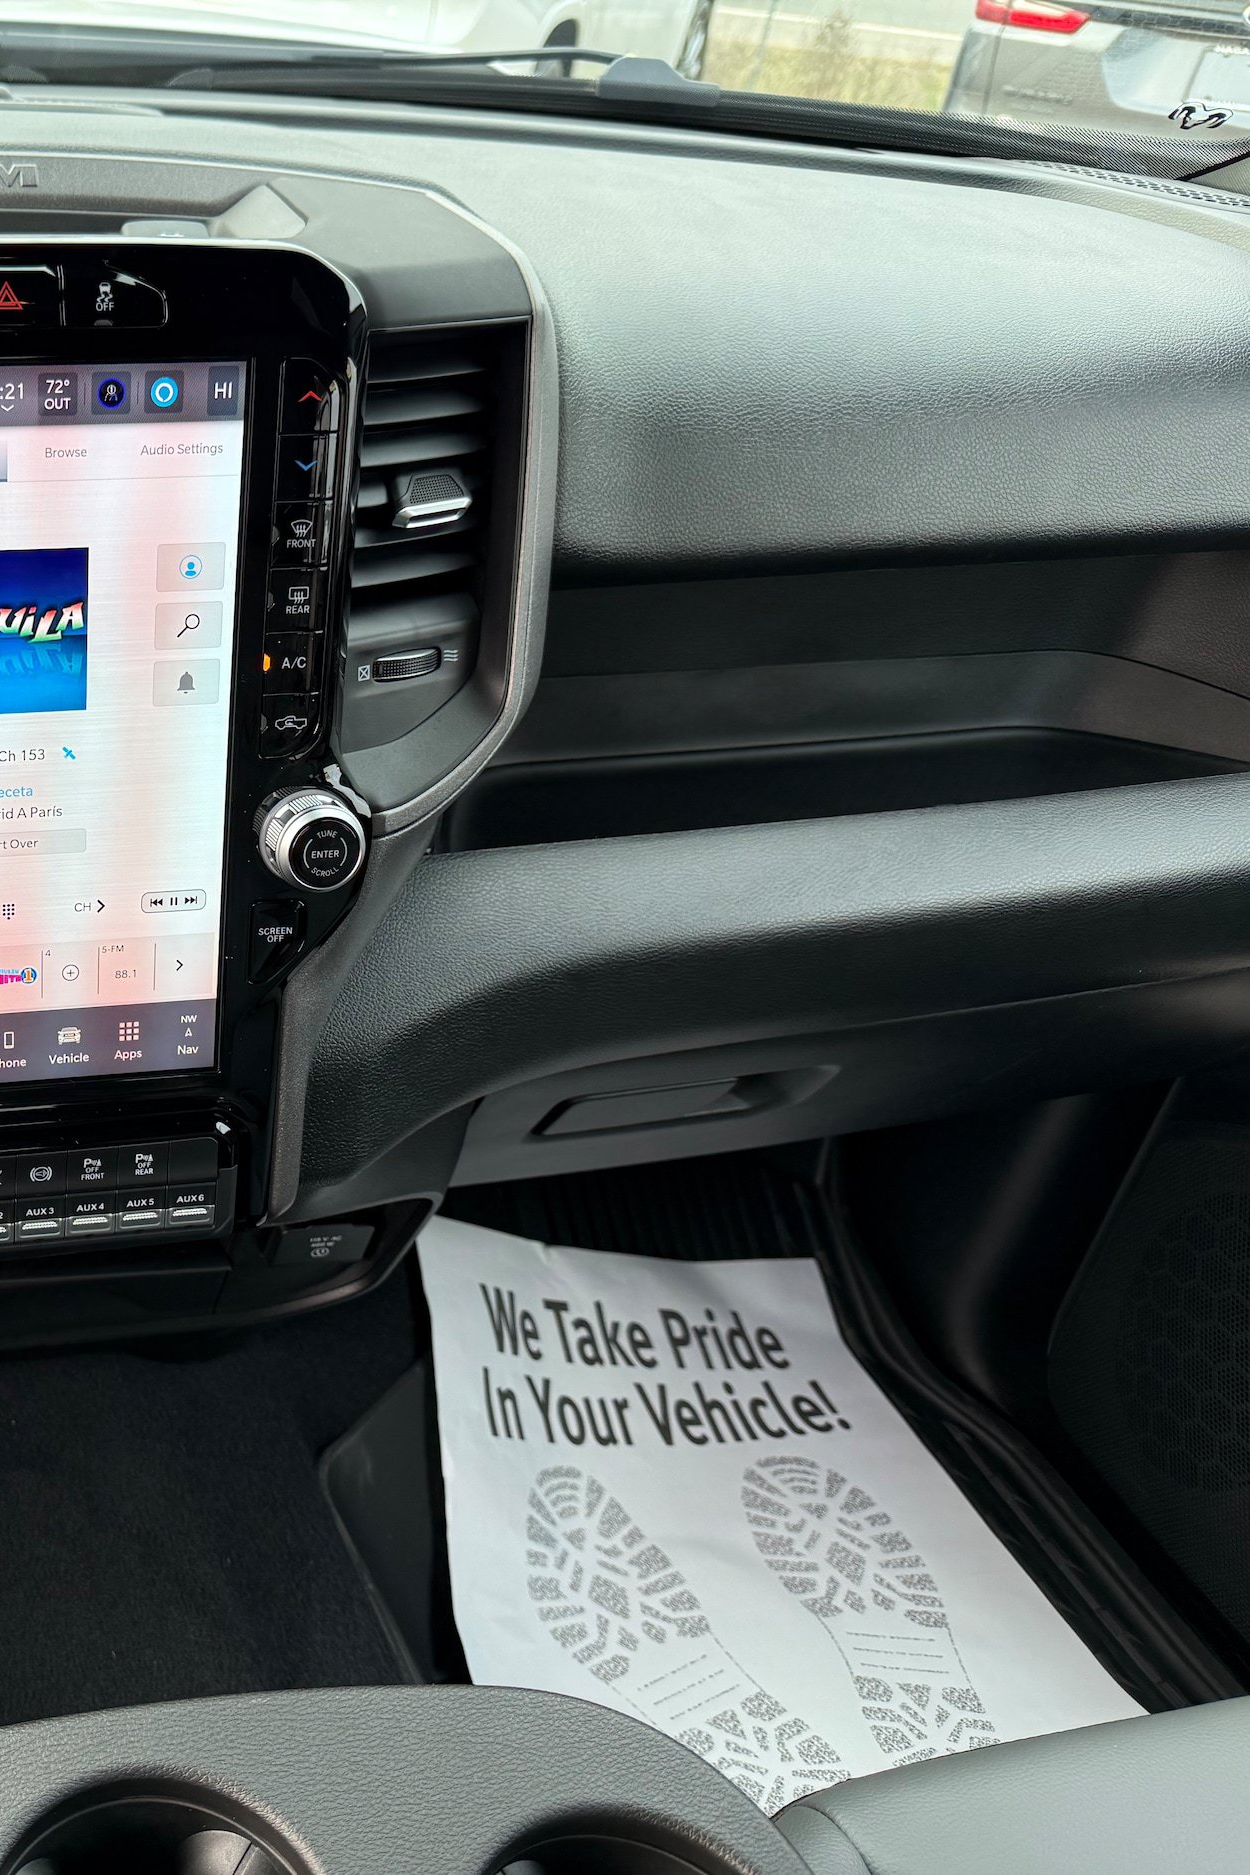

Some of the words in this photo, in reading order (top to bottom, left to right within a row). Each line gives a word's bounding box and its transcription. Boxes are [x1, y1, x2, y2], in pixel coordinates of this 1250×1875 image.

[95, 301, 115, 312] OFF
[214, 381, 233, 400] HI
[44, 398, 71, 411] OUT
[44, 446, 87, 459] Browse
[140, 444, 175, 456] Audio
[177, 443, 224, 456] Settings
[286, 539, 316, 549] FRONT
[285, 604, 311, 615] REAR
[281, 656, 307, 670] A/C
[22, 749, 46, 761] 153
[17, 807, 27, 819] A
[30, 805, 63, 819] París
[316, 829, 339, 840] TUNE
[9, 839, 39, 850] Over
[311, 850, 340, 859] ENTER
[310, 866, 340, 879] SCROLL
[74, 901, 92, 913] CH
[258, 927, 293, 936] SCREEN
[267, 935, 285, 943] OFF
[101, 944, 125, 954] 5-FM
[114, 968, 137, 979] 88.1
[180, 1014, 197, 1024] NW
[114, 1048, 142, 1062] Apps
[177, 1044, 199, 1056] Nav
[49, 1051, 90, 1065] Vehicle
[85, 1166, 100, 1174] OFF
[137, 1161, 152, 1169] OFF
[81, 1172, 104, 1181] FRONT
[135, 1167, 154, 1176] REAR
[126, 1199, 148, 1207] AUX
[148, 1197, 155, 1206] 5
[176, 1194, 198, 1203] AUX
[198, 1193, 205, 1202] 6
[25, 1208, 47, 1217] AUX
[48, 1206, 54, 1215] 3
[76, 1203, 97, 1212] AUX
[98, 1202, 105, 1211] 4
[478, 1283, 544, 1359] We
[543, 1297, 657, 1370] Take
[658, 1307, 791, 1373] Pride
[481, 1367, 527, 1441] In
[526, 1375, 635, 1447] Your
[635, 1379, 852, 1447] Vehicle!
